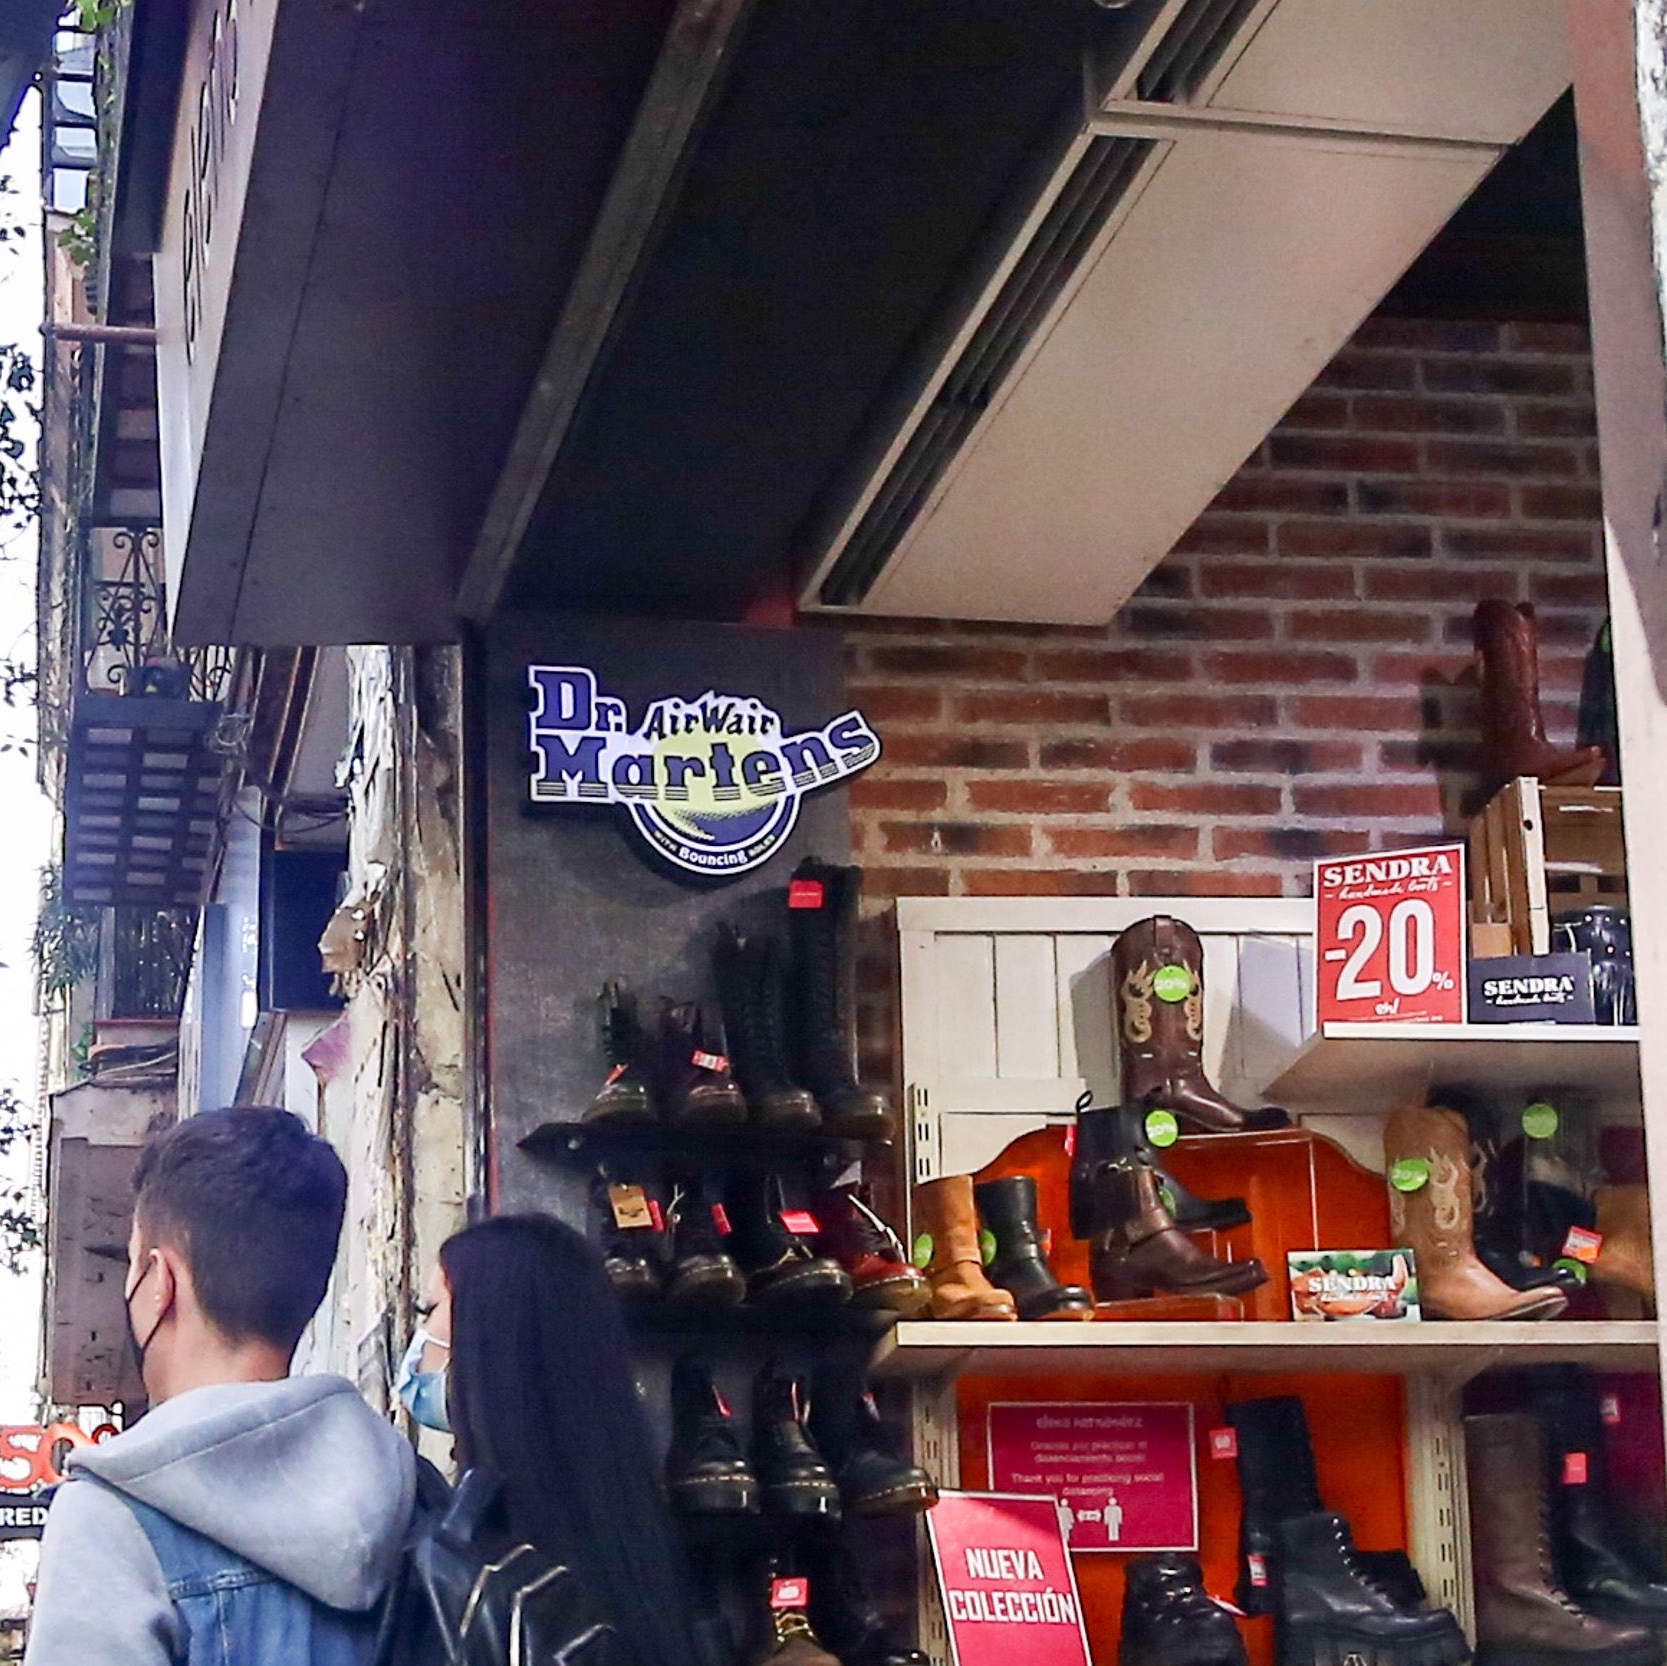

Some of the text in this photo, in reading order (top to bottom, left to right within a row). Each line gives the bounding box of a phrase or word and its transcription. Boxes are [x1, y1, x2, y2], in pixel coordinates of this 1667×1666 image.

[534, 670, 624, 732] Dr.
[643, 700, 776, 741] AirWair
[533, 717, 876, 800] Martens
[679, 846, 748, 866] Bouncing
[1323, 854, 1452, 888] SENDRA
[1484, 976, 1573, 996] SENDRA
[1308, 1276, 1396, 1292] SENDRA
[965, 1547, 1044, 1581] NUEVA
[947, 1587, 1077, 1624] COLECCIÓN
